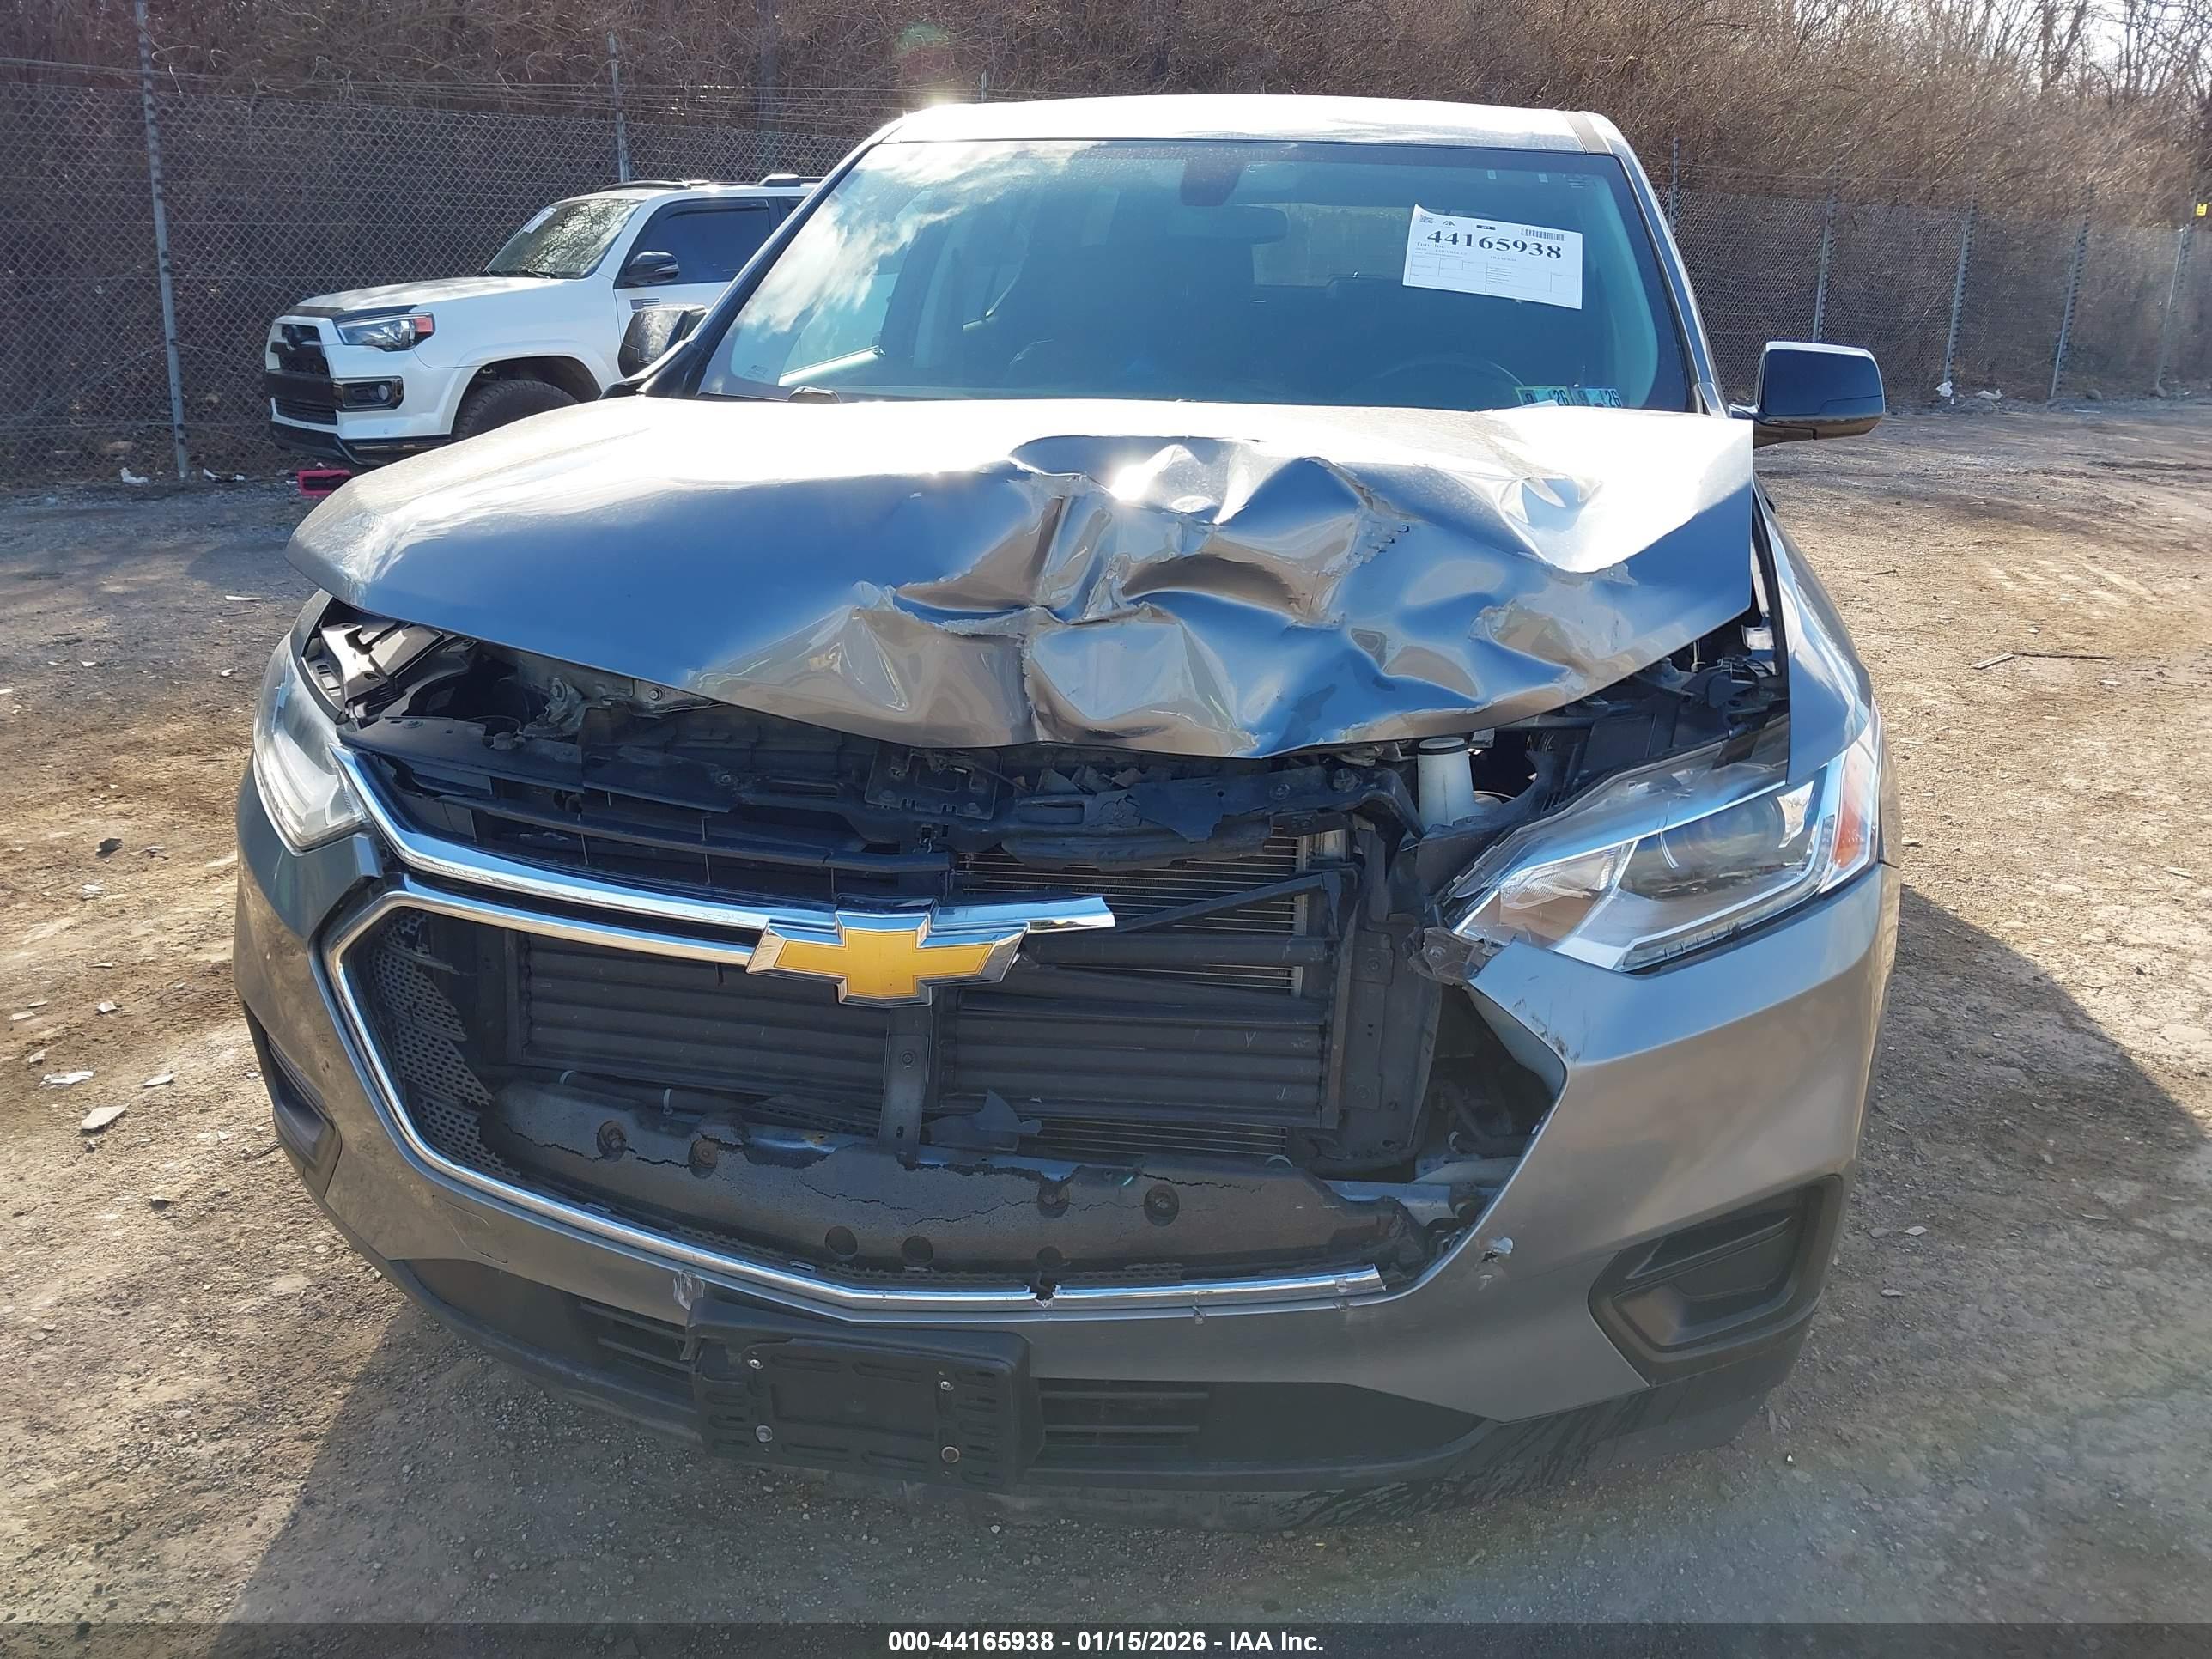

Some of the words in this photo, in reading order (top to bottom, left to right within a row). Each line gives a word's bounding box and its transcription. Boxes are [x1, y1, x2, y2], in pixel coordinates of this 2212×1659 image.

[1426, 230, 1562, 259] 44165938
[1553, 389, 1571, 406] 26
[1604, 390, 1622, 407] 26
